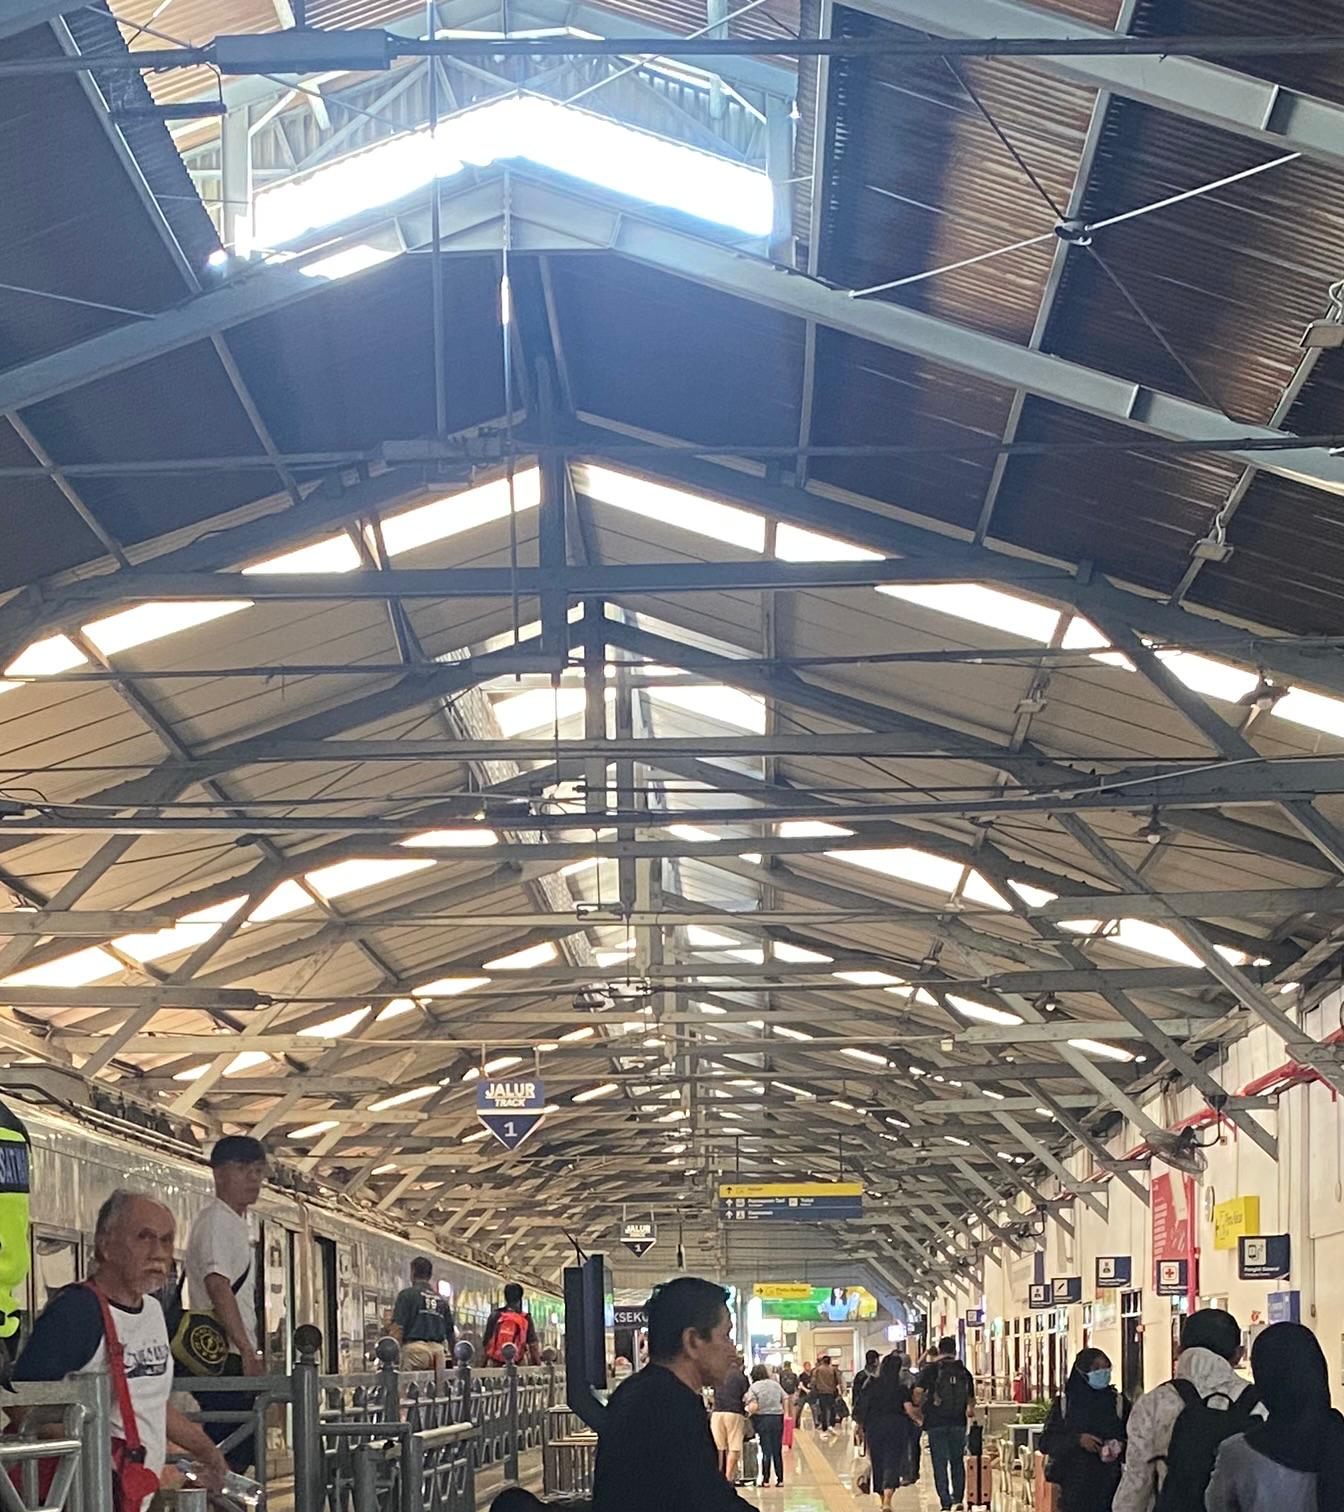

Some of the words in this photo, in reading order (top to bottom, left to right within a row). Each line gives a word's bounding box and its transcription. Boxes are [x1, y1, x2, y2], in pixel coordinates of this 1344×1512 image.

[484, 1082, 536, 1099] JALUR
[495, 1098, 525, 1107] TRACK
[503, 1121, 518, 1137] 1
